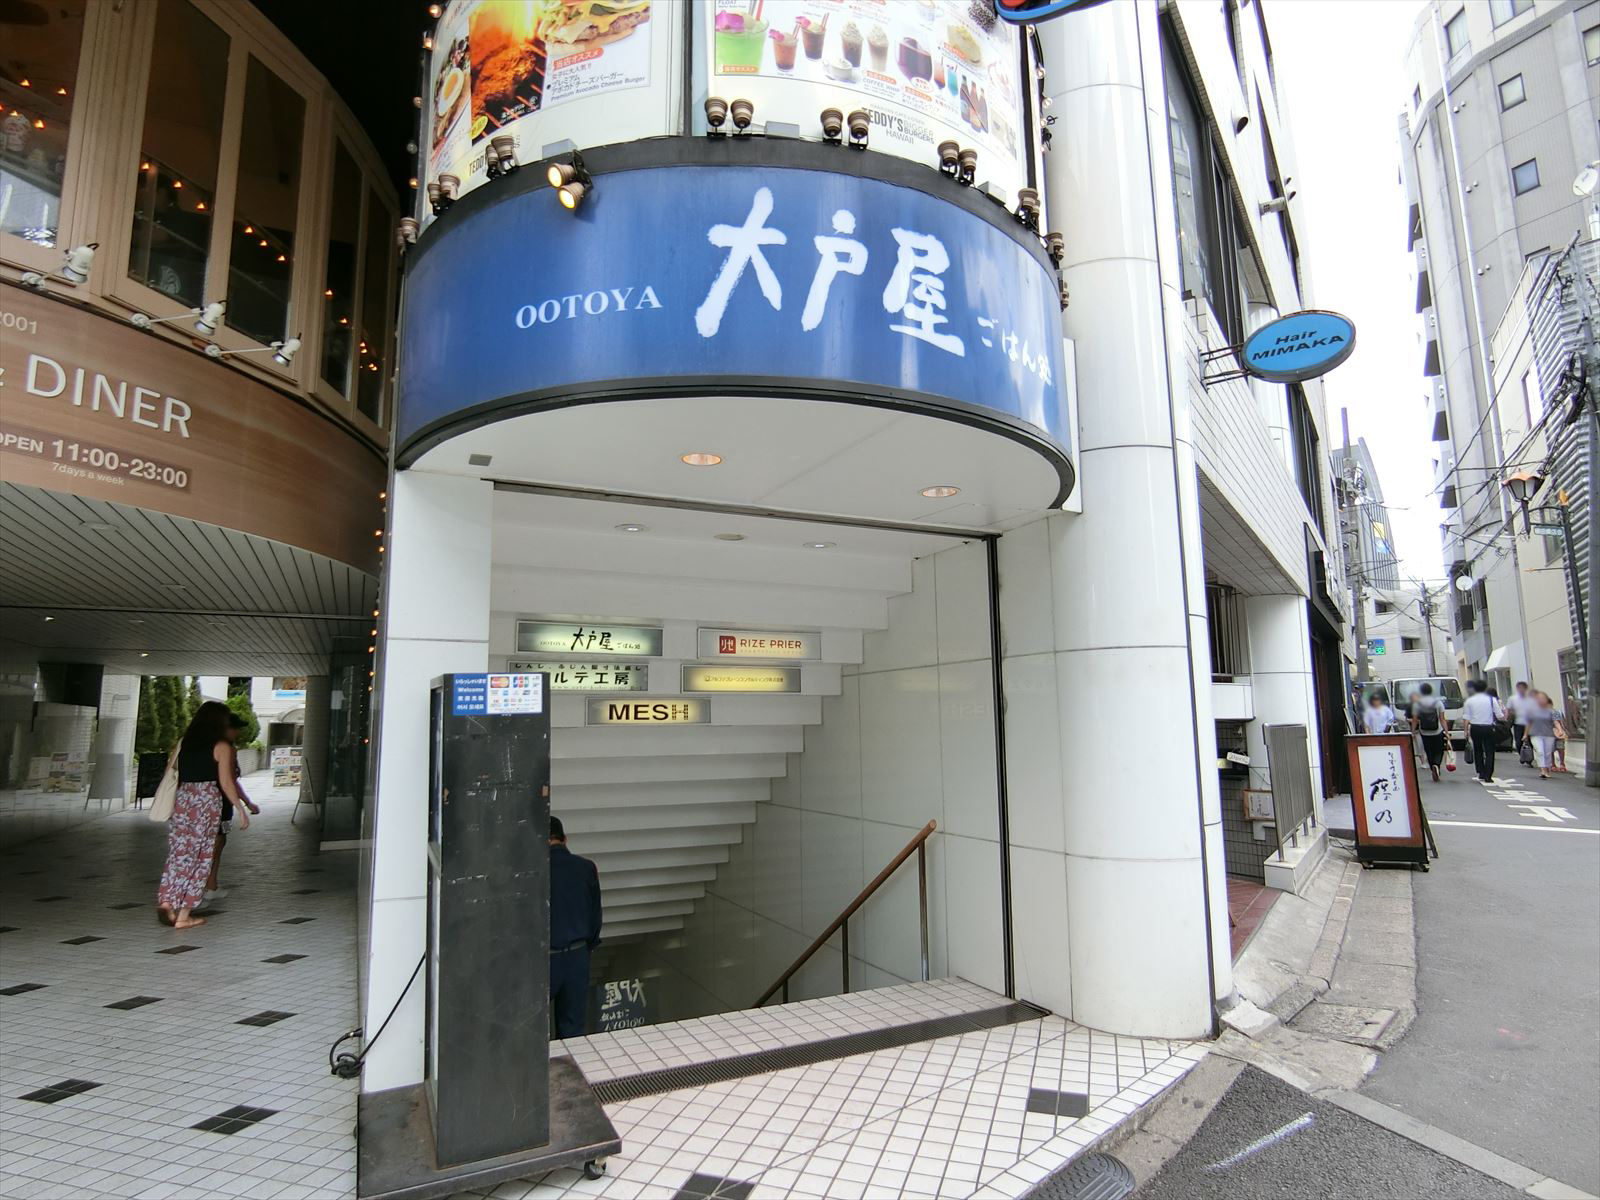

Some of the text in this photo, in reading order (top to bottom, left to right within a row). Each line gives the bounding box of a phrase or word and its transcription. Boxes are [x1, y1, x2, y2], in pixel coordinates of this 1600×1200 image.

[886, 129, 914, 144] HAWAII
[904, 127, 934, 144] BURGERS
[515, 285, 663, 329] OOTOYA
[695, 186, 965, 357] 大戸屋
[1275, 330, 1317, 345] Hair
[1252, 335, 1345, 361] MIMAKA
[26, 353, 192, 438] DINER
[52, 439, 187, 488] 11:00-23:00
[97, 473, 124, 486] week
[570, 627, 614, 651] 大戸屋
[740, 638, 802, 649] RIZE PRIER
[609, 704, 689, 720] MESH
